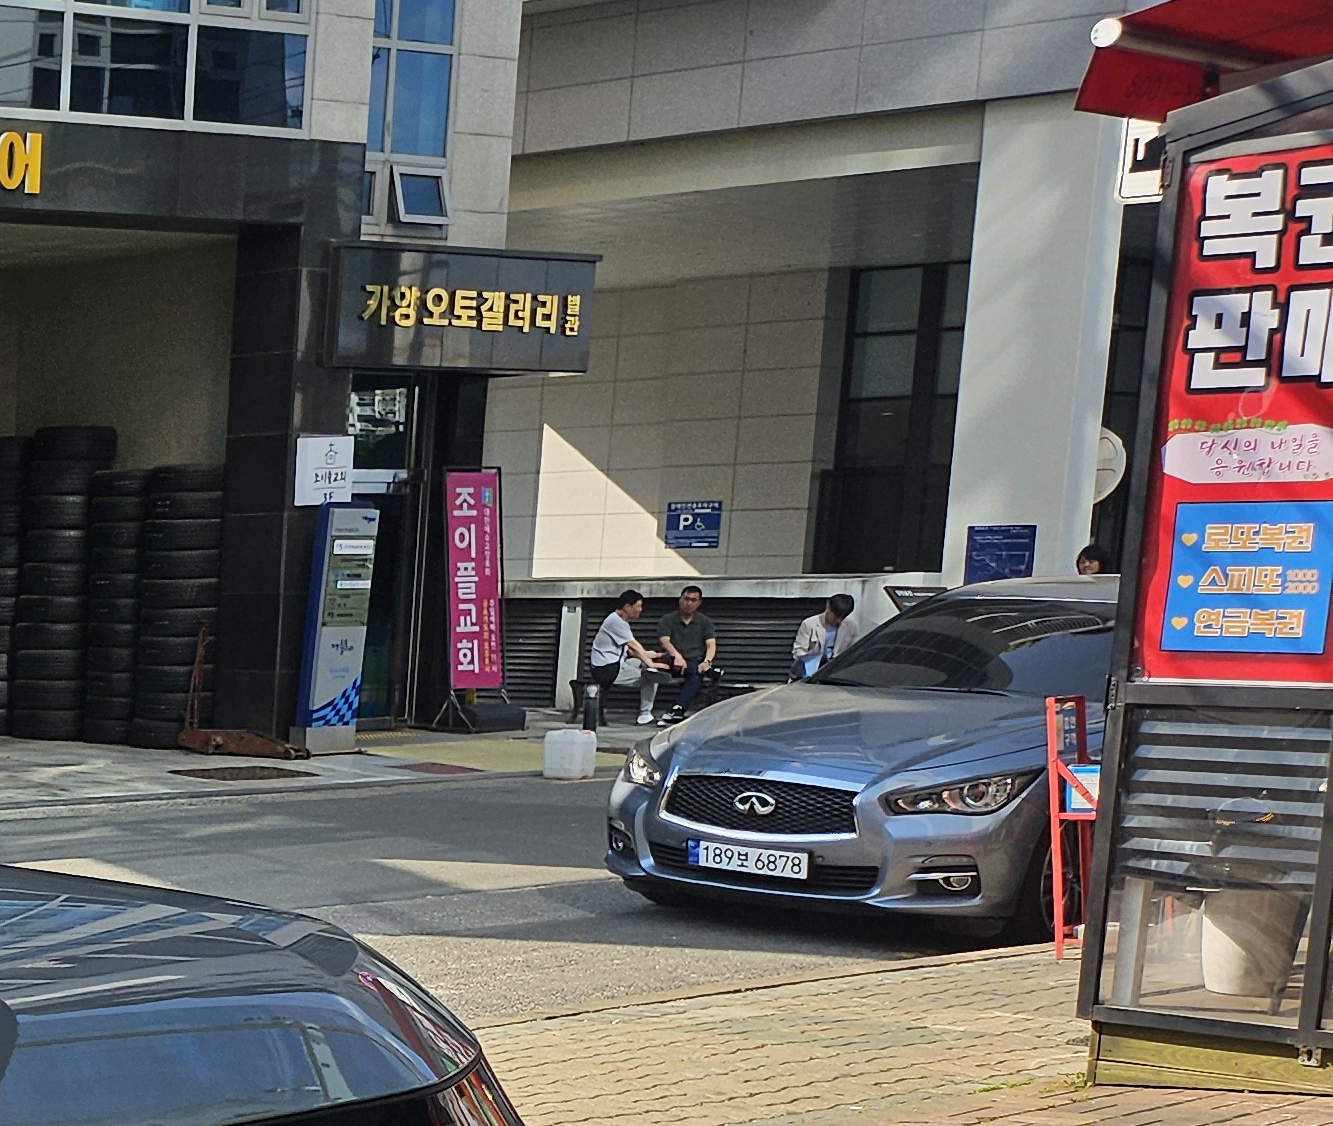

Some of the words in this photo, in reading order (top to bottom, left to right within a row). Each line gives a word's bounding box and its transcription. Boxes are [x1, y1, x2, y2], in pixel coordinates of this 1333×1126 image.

[361, 284, 559, 335] 가양오토갤러리
[1200, 437, 1258, 456] 당신의
[1270, 432, 1319, 455] 내일을
[1209, 457, 1313, 477] 응원합니다
[678, 514, 694, 531] P
[1201, 523, 1315, 553] 로또복권
[453, 487, 480, 674] 조이플교회
[1197, 566, 1283, 594] 스피또
[1193, 608, 1306, 638] 연금복권
[702, 845, 749, 869] 189보
[754, 851, 802, 876] 6878
